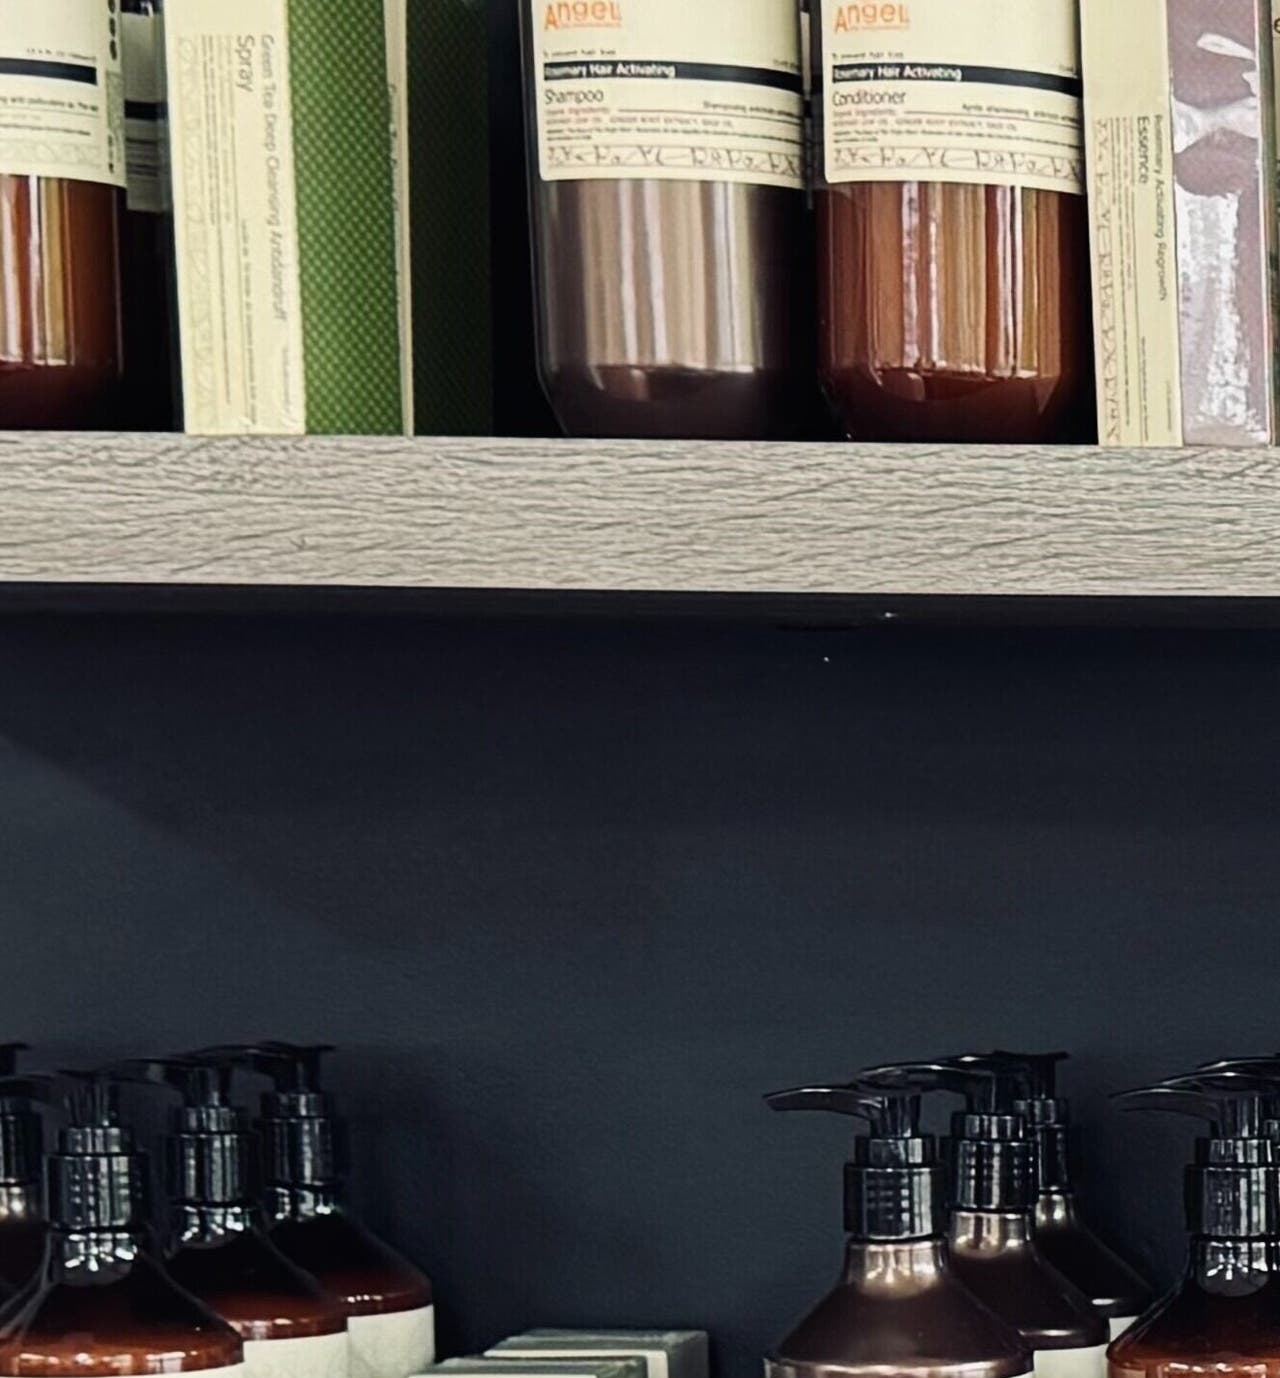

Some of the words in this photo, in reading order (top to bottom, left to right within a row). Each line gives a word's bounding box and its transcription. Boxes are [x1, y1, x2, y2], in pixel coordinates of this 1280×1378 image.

[235, 35, 255, 92] Spray
[589, 63, 613, 77] Hair
[616, 63, 676, 79] Activating
[877, 66, 900, 79] Hair
[903, 65, 962, 82] Activating
[832, 89, 906, 107] Conditioner
[1137, 115, 1150, 184] Essence
